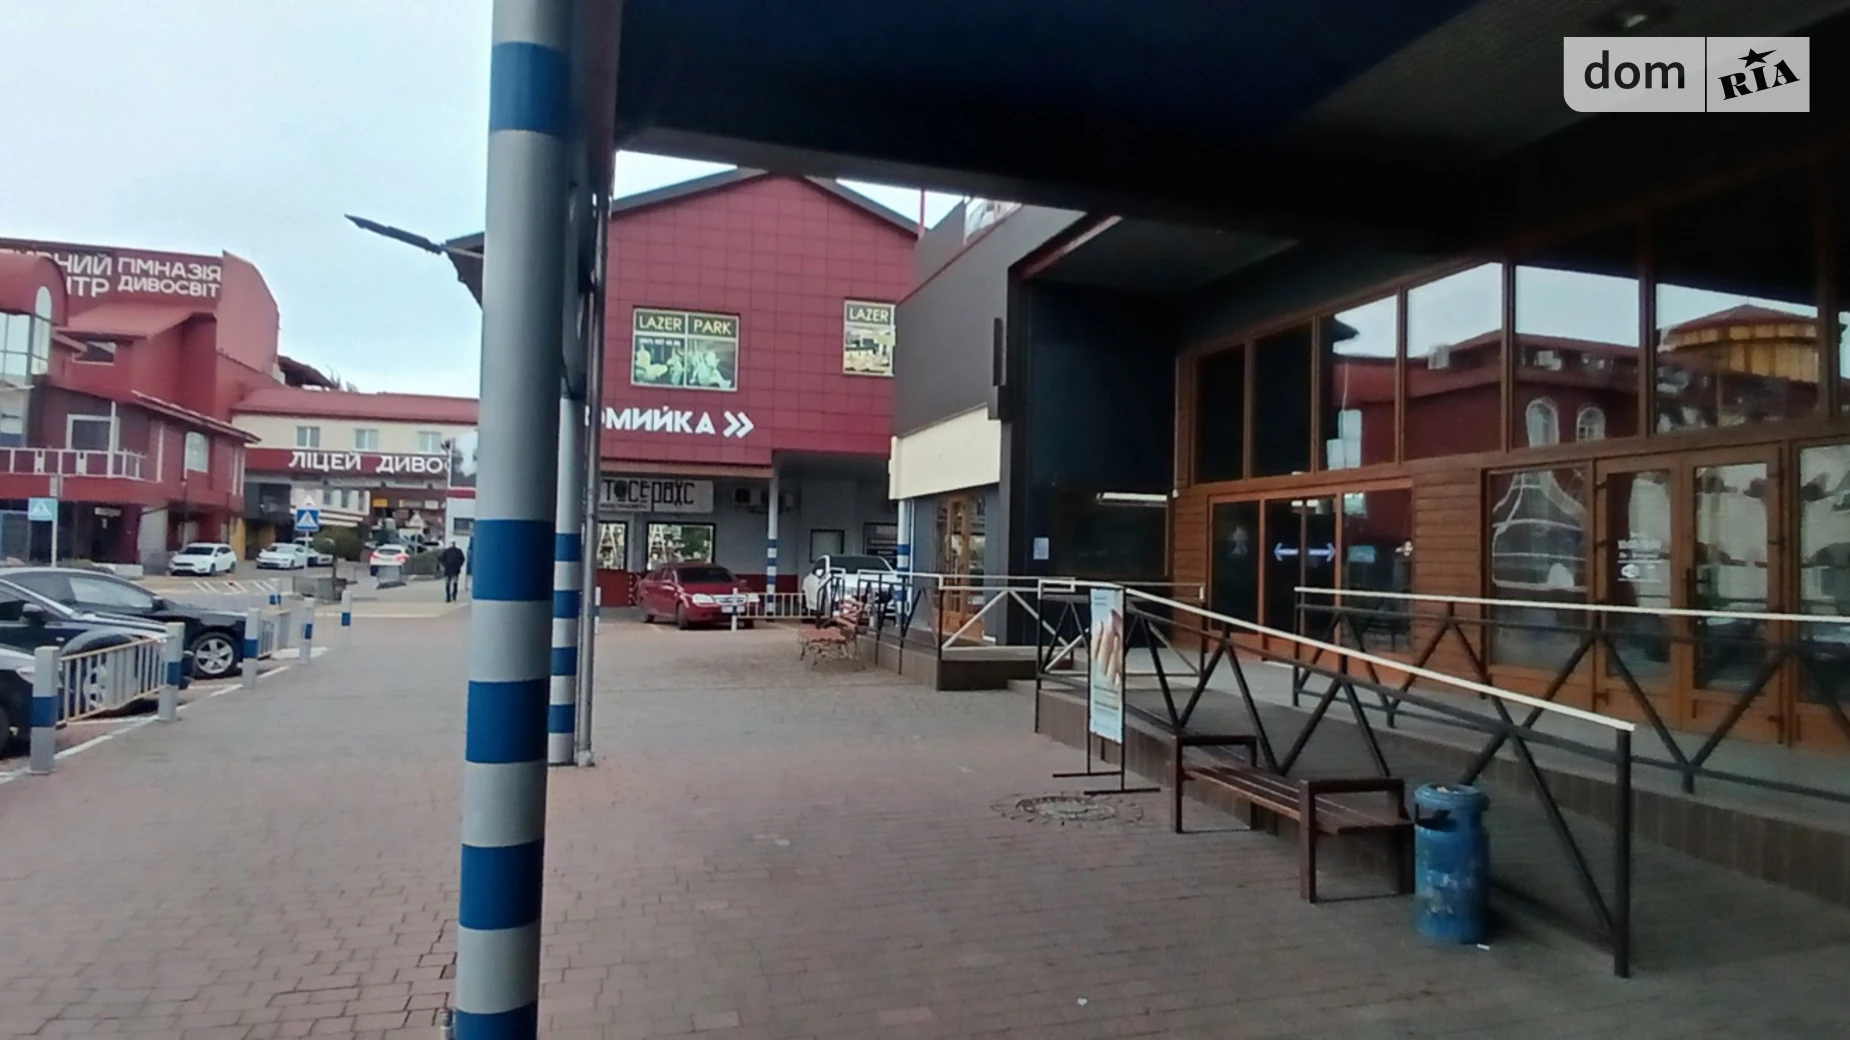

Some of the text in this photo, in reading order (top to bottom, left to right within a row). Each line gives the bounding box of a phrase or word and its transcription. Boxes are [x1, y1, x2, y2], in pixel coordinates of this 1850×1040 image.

[117, 275, 221, 298] ДИВОСВІТ
[639, 315, 732, 335] LAZER PARK
[849, 307, 889, 322] LAZER
[288, 450, 362, 473] ЛІЦЕЙ
